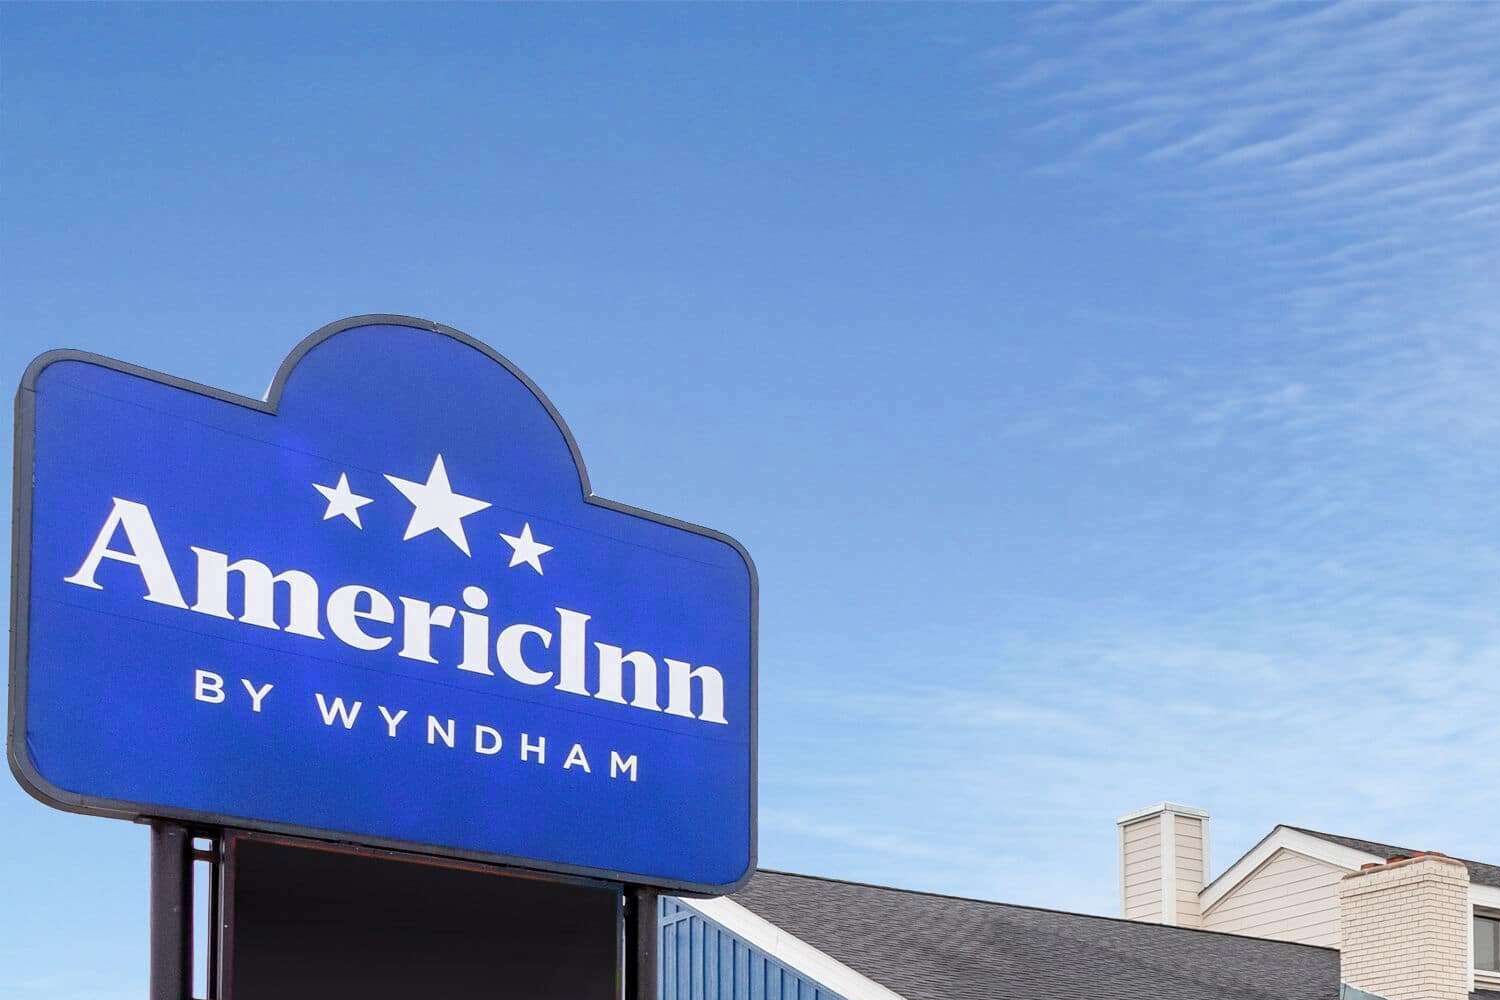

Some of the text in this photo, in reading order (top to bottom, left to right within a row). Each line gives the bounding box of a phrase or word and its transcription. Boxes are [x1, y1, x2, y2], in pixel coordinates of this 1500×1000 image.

[63, 496, 729, 725] AmericInn
[194, 669, 638, 782] BY WYNDHAM
